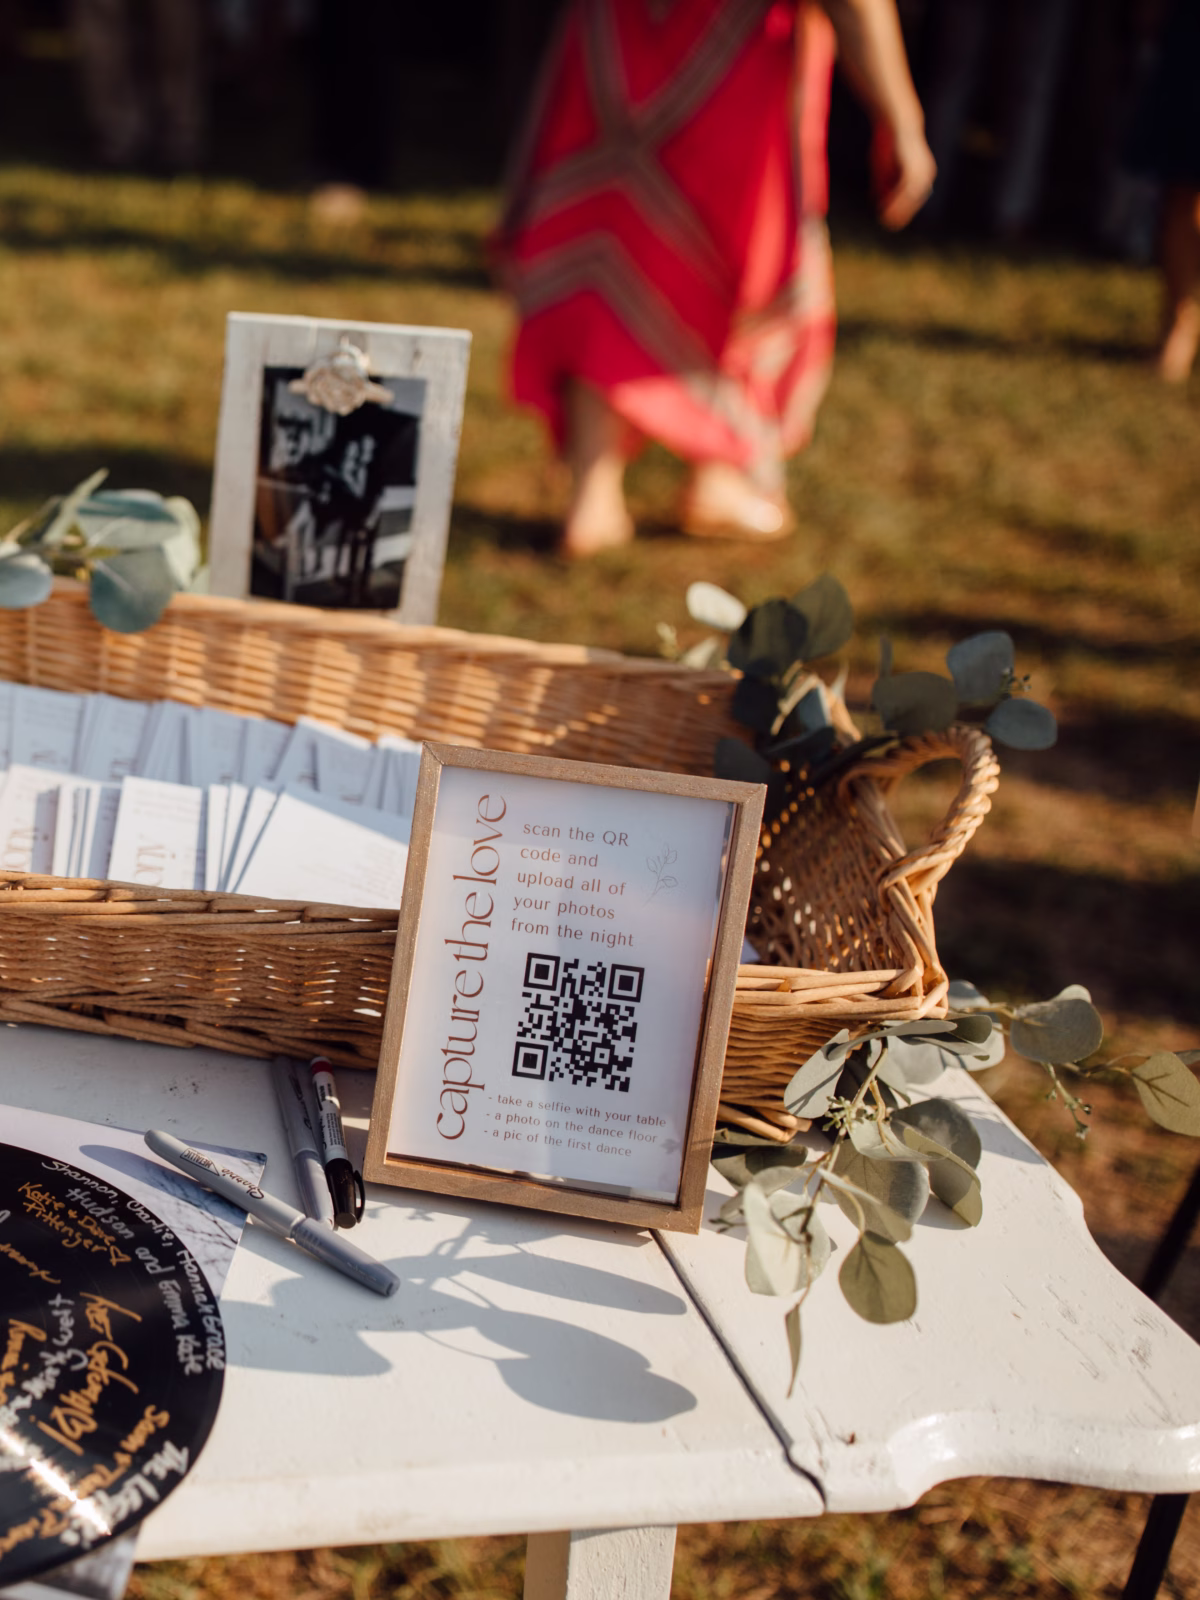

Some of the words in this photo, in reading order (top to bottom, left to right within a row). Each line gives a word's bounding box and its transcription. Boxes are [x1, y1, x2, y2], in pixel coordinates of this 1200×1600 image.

[452, 793, 508, 887] love
[522, 823, 561, 838] scan
[569, 826, 595, 842] the
[602, 830, 629, 847] QR
[520, 848, 561, 863] code
[567, 854, 599, 868] and
[517, 871, 575, 889] upload
[580, 878, 601, 893] all
[608, 882, 627, 896] of
[512, 896, 551, 911] your
[557, 900, 616, 920] photos
[444, 890, 496, 964] the
[511, 917, 550, 936] from
[557, 924, 583, 941] the
[590, 929, 635, 949] night
[436, 968, 486, 1141] capture
[497, 1094, 523, 1107] take
[526, 1099, 534, 1109] a
[537, 1100, 571, 1114] selfie
[575, 1106, 601, 1118] with
[604, 1110, 632, 1123] your
[636, 1114, 667, 1128] table
[494, 1112, 502, 1121] a
[505, 1110, 541, 1126] photo
[545, 1119, 560, 1129] on
[565, 1120, 584, 1133] the
[588, 1124, 624, 1139] dance
[628, 1129, 658, 1144] floor
[492, 1128, 499, 1138] a
[503, 1128, 523, 1142] pic
[526, 1133, 539, 1143] of
[544, 1135, 563, 1147] the
[567, 1138, 592, 1151] first
[596, 1142, 633, 1157] dance
[184, 1150, 214, 1169] METALLIC
